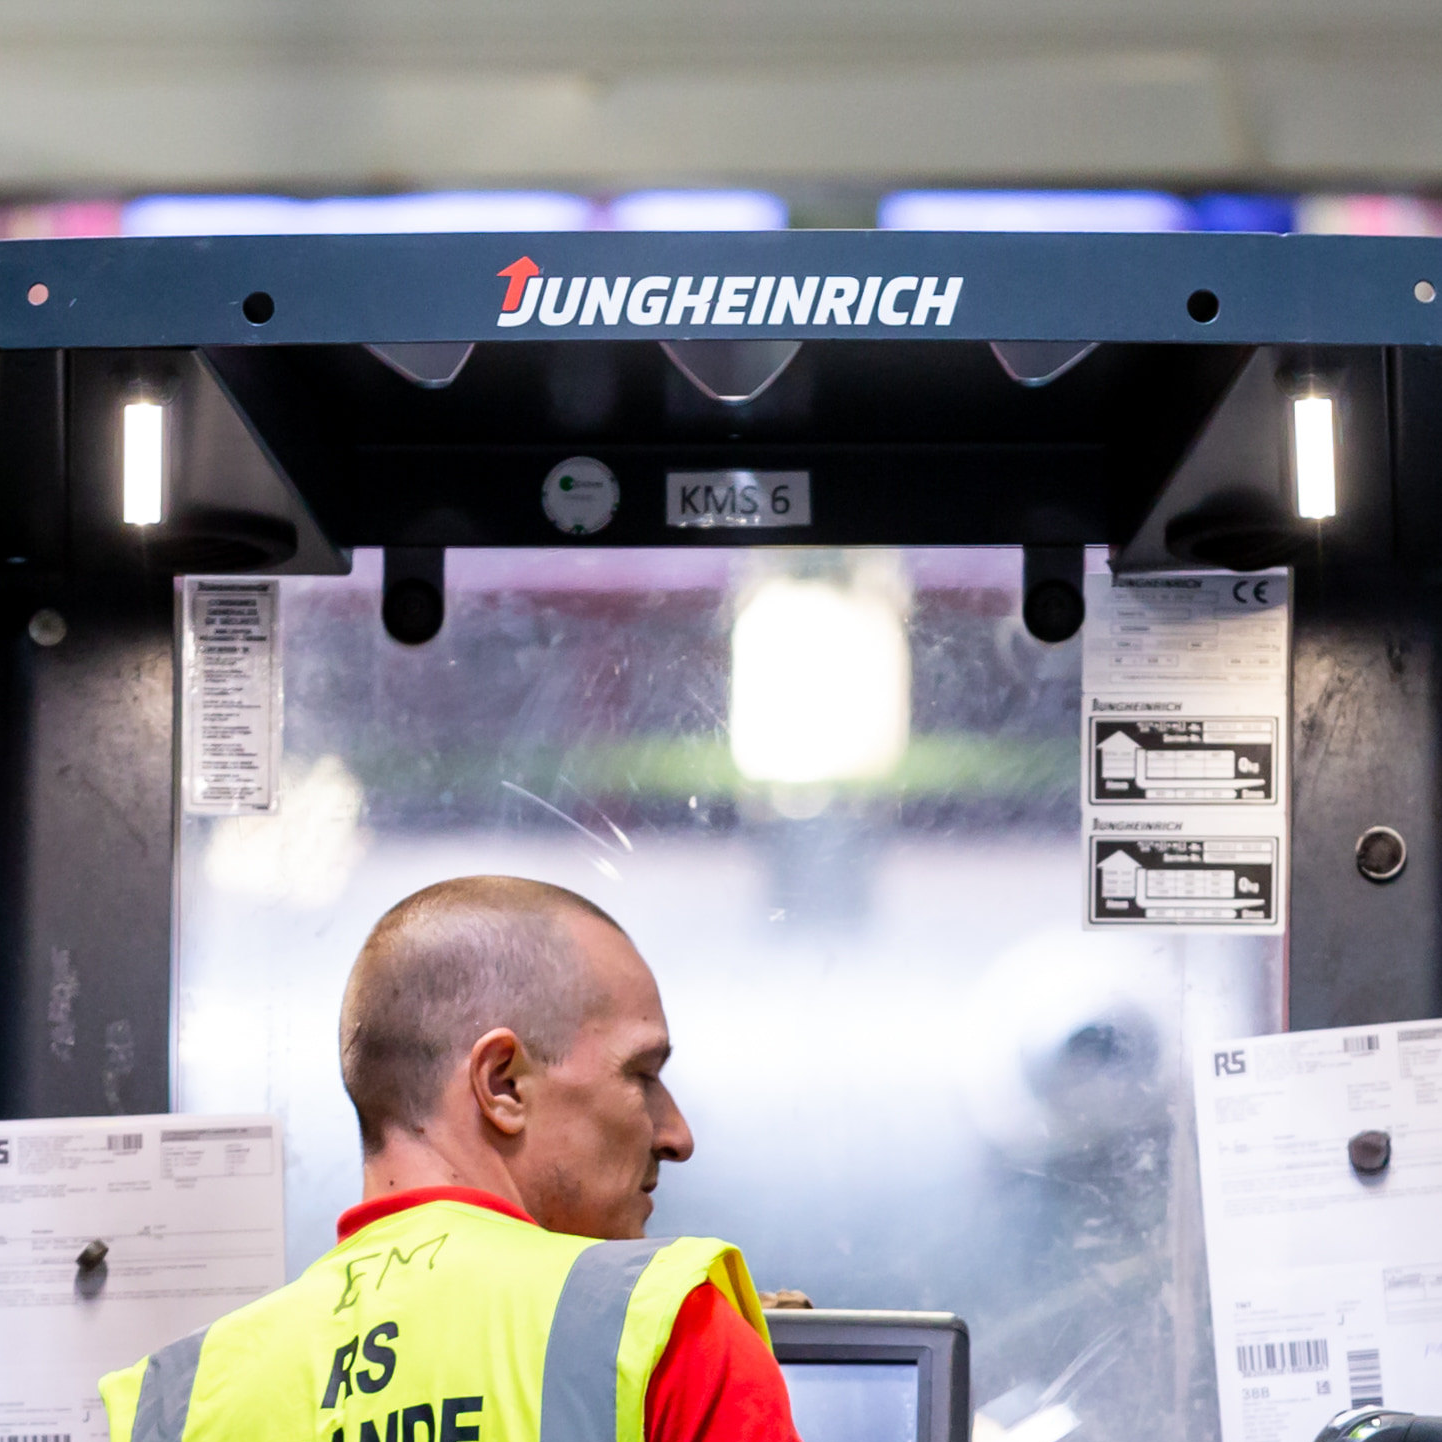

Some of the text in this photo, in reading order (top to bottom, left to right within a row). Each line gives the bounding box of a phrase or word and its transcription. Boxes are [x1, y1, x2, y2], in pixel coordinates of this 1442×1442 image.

[496, 257, 964, 327] JUNGHEINRICH
[680, 485, 791, 515] KMS 6
[1092, 698, 1183, 712] JUNGHEINRICH
[1092, 818, 1184, 831] JUNGHEINRICH
[1214, 1050, 1246, 1077] RS
[321, 1320, 399, 1409] RS
